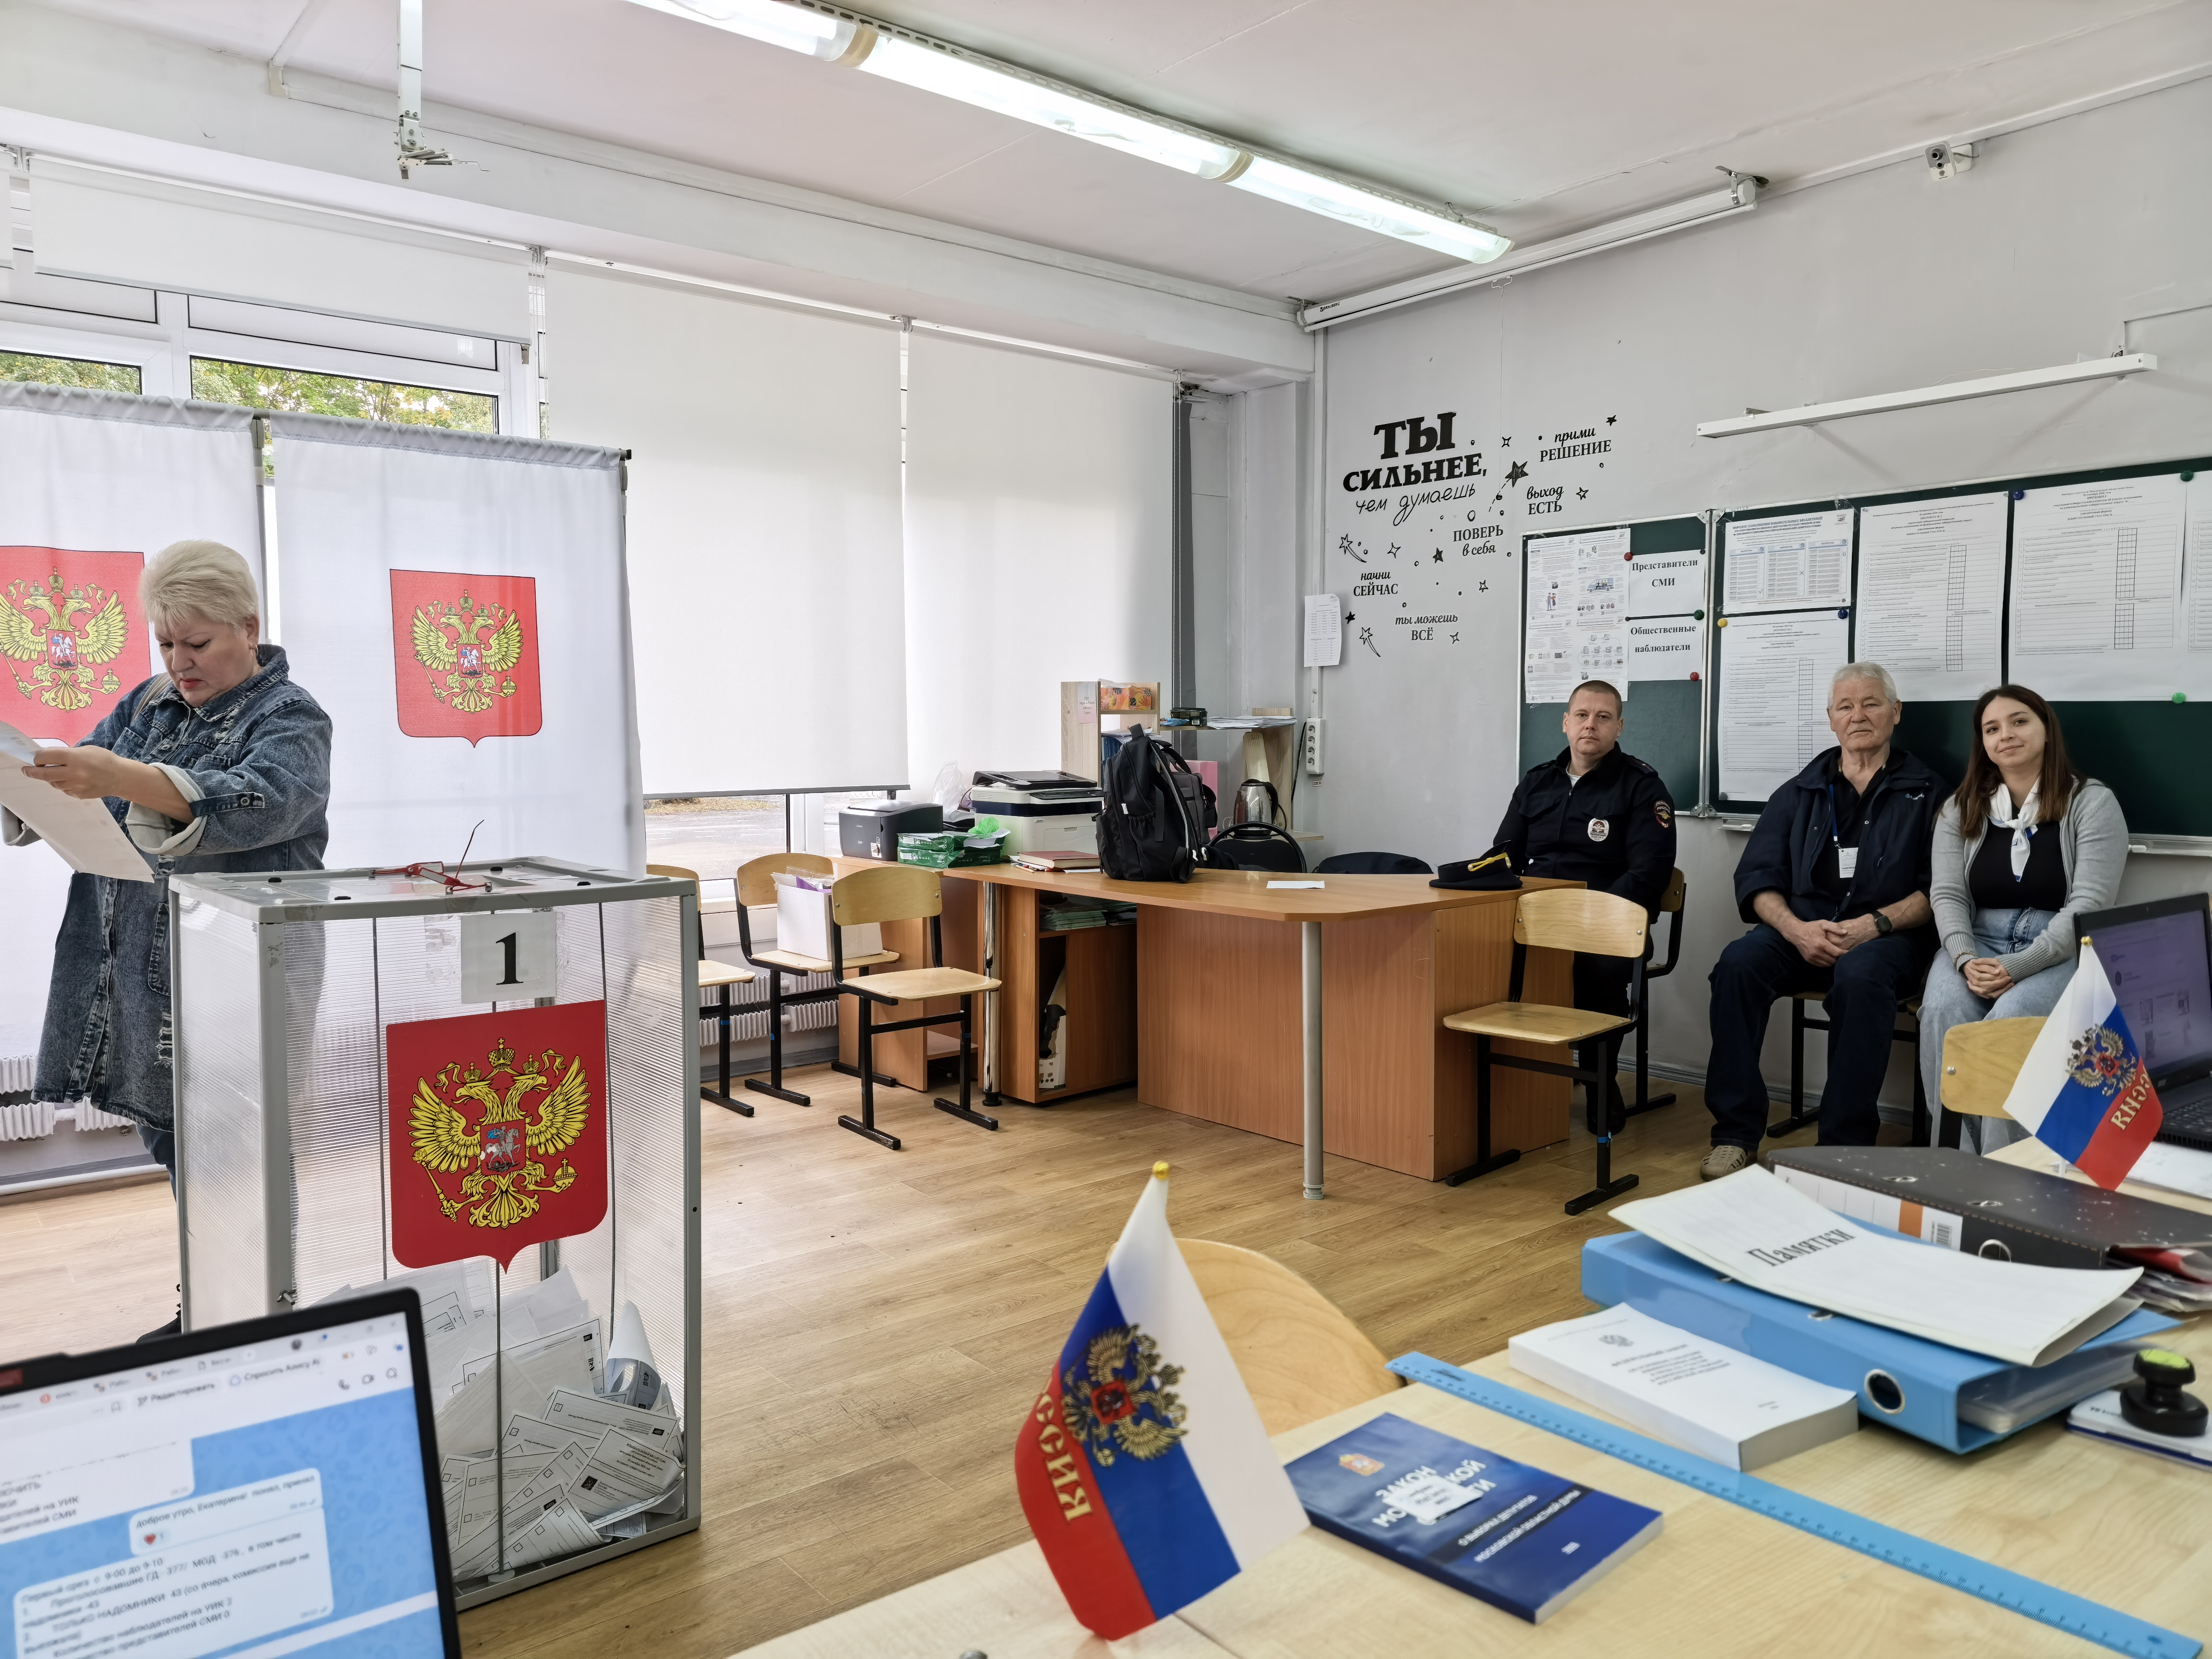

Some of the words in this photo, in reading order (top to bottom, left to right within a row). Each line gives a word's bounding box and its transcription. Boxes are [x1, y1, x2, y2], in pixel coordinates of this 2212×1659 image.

[1374, 412, 1456, 460] ТЫ
[1555, 427, 1596, 444] прими
[1540, 440, 1611, 463] РЕШЕНИЕ
[1343, 453, 1487, 492] СИЛЬНЕЕ,
[1527, 486, 1564, 501] выход
[1356, 497, 1387, 515] чем
[1393, 483, 1475, 526] думаешь
[1528, 500, 1562, 515] ЕСТЬ
[1453, 525, 1504, 542] ПОВЕРЬ
[1462, 544, 1471, 556] в
[1472, 543, 1496, 555] себя
[1632, 559, 1698, 572] Представители
[1360, 570, 1391, 581] начни
[1651, 578, 1675, 587] СМИ
[1353, 582, 1398, 597] СЕЙЧАС
[1395, 616, 1411, 625] ты
[1413, 613, 1458, 624] можешь
[1411, 628, 1434, 640] ВСЁ
[1630, 625, 1696, 636] Общественные
[1635, 643, 1690, 653] наблюдатели
[495, 932, 523, 986] 1
[1747, 1229, 1856, 1267] Памятки
[150, 1382, 215, 1403] Редактировать
[1036, 1382, 1092, 1522] ССИЯ
[1375, 1466, 1437, 1499] ЗАКОН
[58, 1495, 79, 1507] УИК
[52, 1508, 76, 1520] СМИ
[136, 1514, 170, 1528] доброе
[128, 1565, 140, 1576] до
[143, 1557, 164, 1570] 9-10
[192, 1555, 217, 1568] МОД
[97, 1593, 165, 1619] НАДОМНИКИ
[117, 1610, 188, 1638] наблюдателей
[191, 1608, 203, 1617] на
[205, 1601, 225, 1612] УИК
[118, 1621, 197, 1651] представителей
[199, 1613, 222, 1624] СМИ
